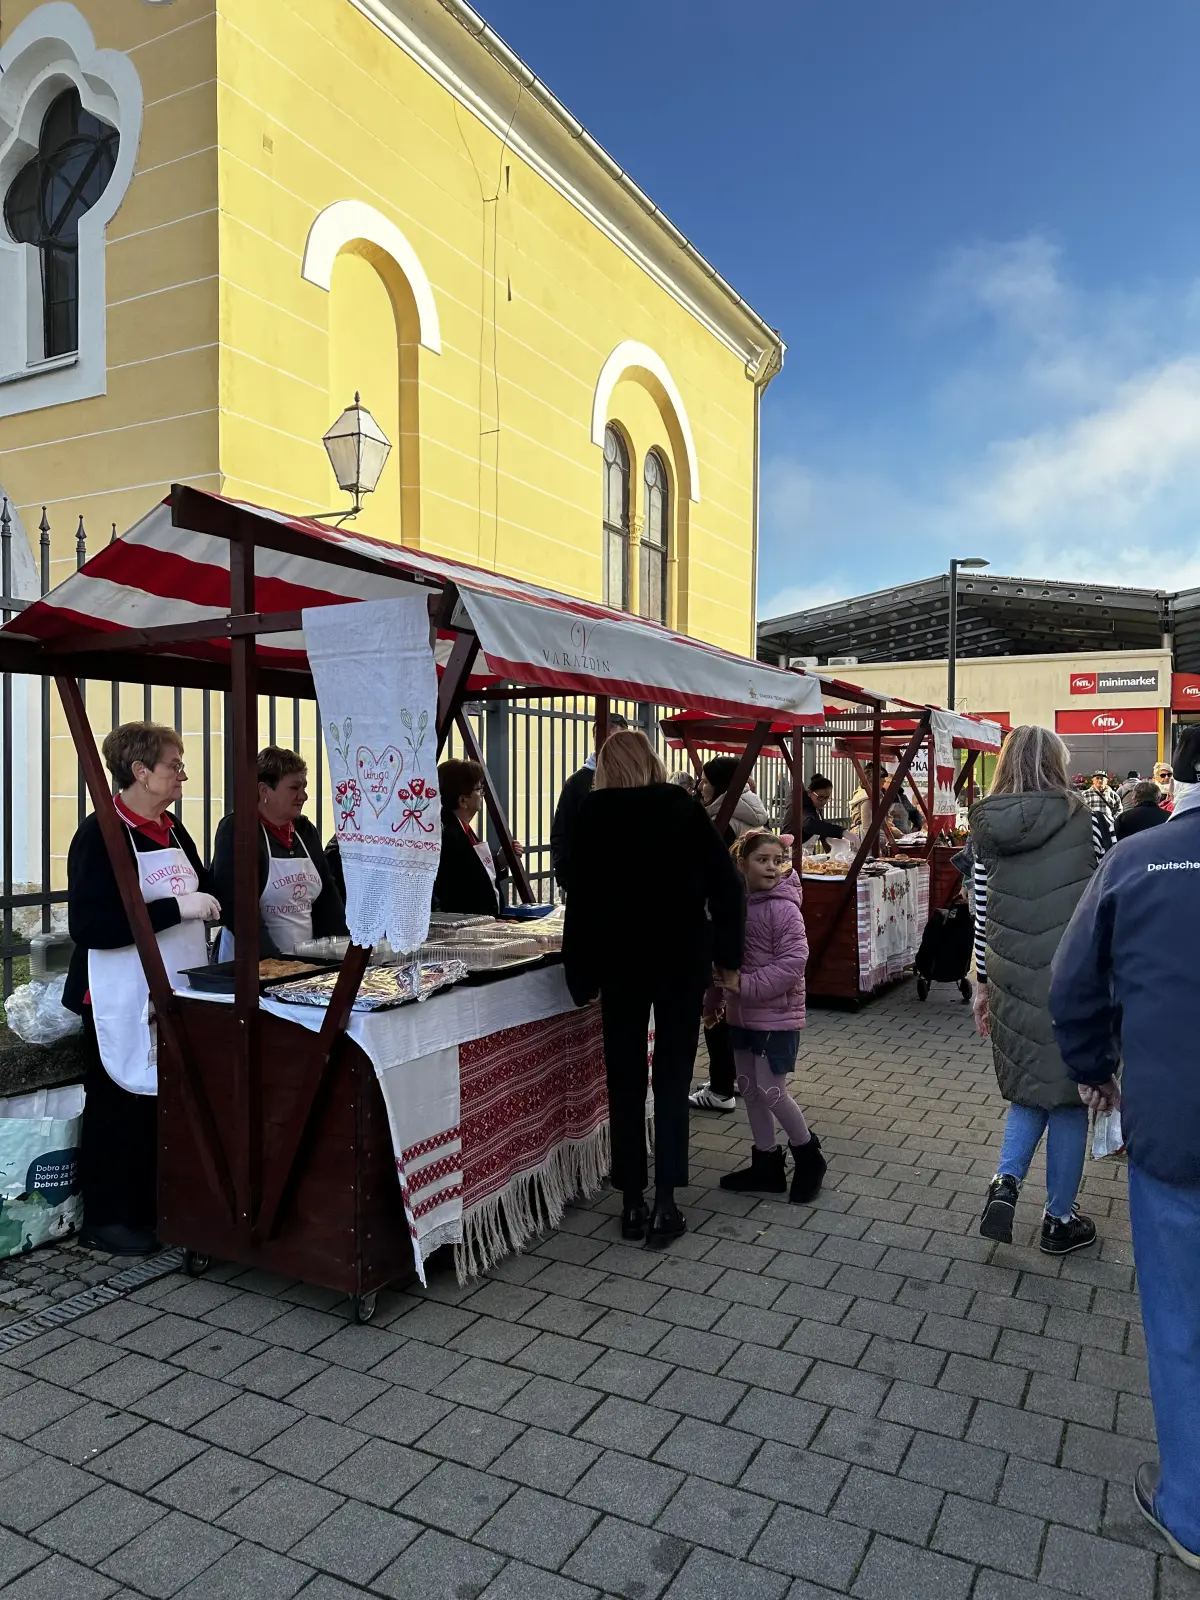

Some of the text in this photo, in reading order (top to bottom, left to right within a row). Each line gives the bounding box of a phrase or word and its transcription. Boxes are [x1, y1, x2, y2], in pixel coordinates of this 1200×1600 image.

[1099, 676, 1156, 687] minimarket
[908, 761, 928, 772] PKA
[1147, 860, 1200, 872] Deutsche
[36, 1164, 60, 1172] Dobro
